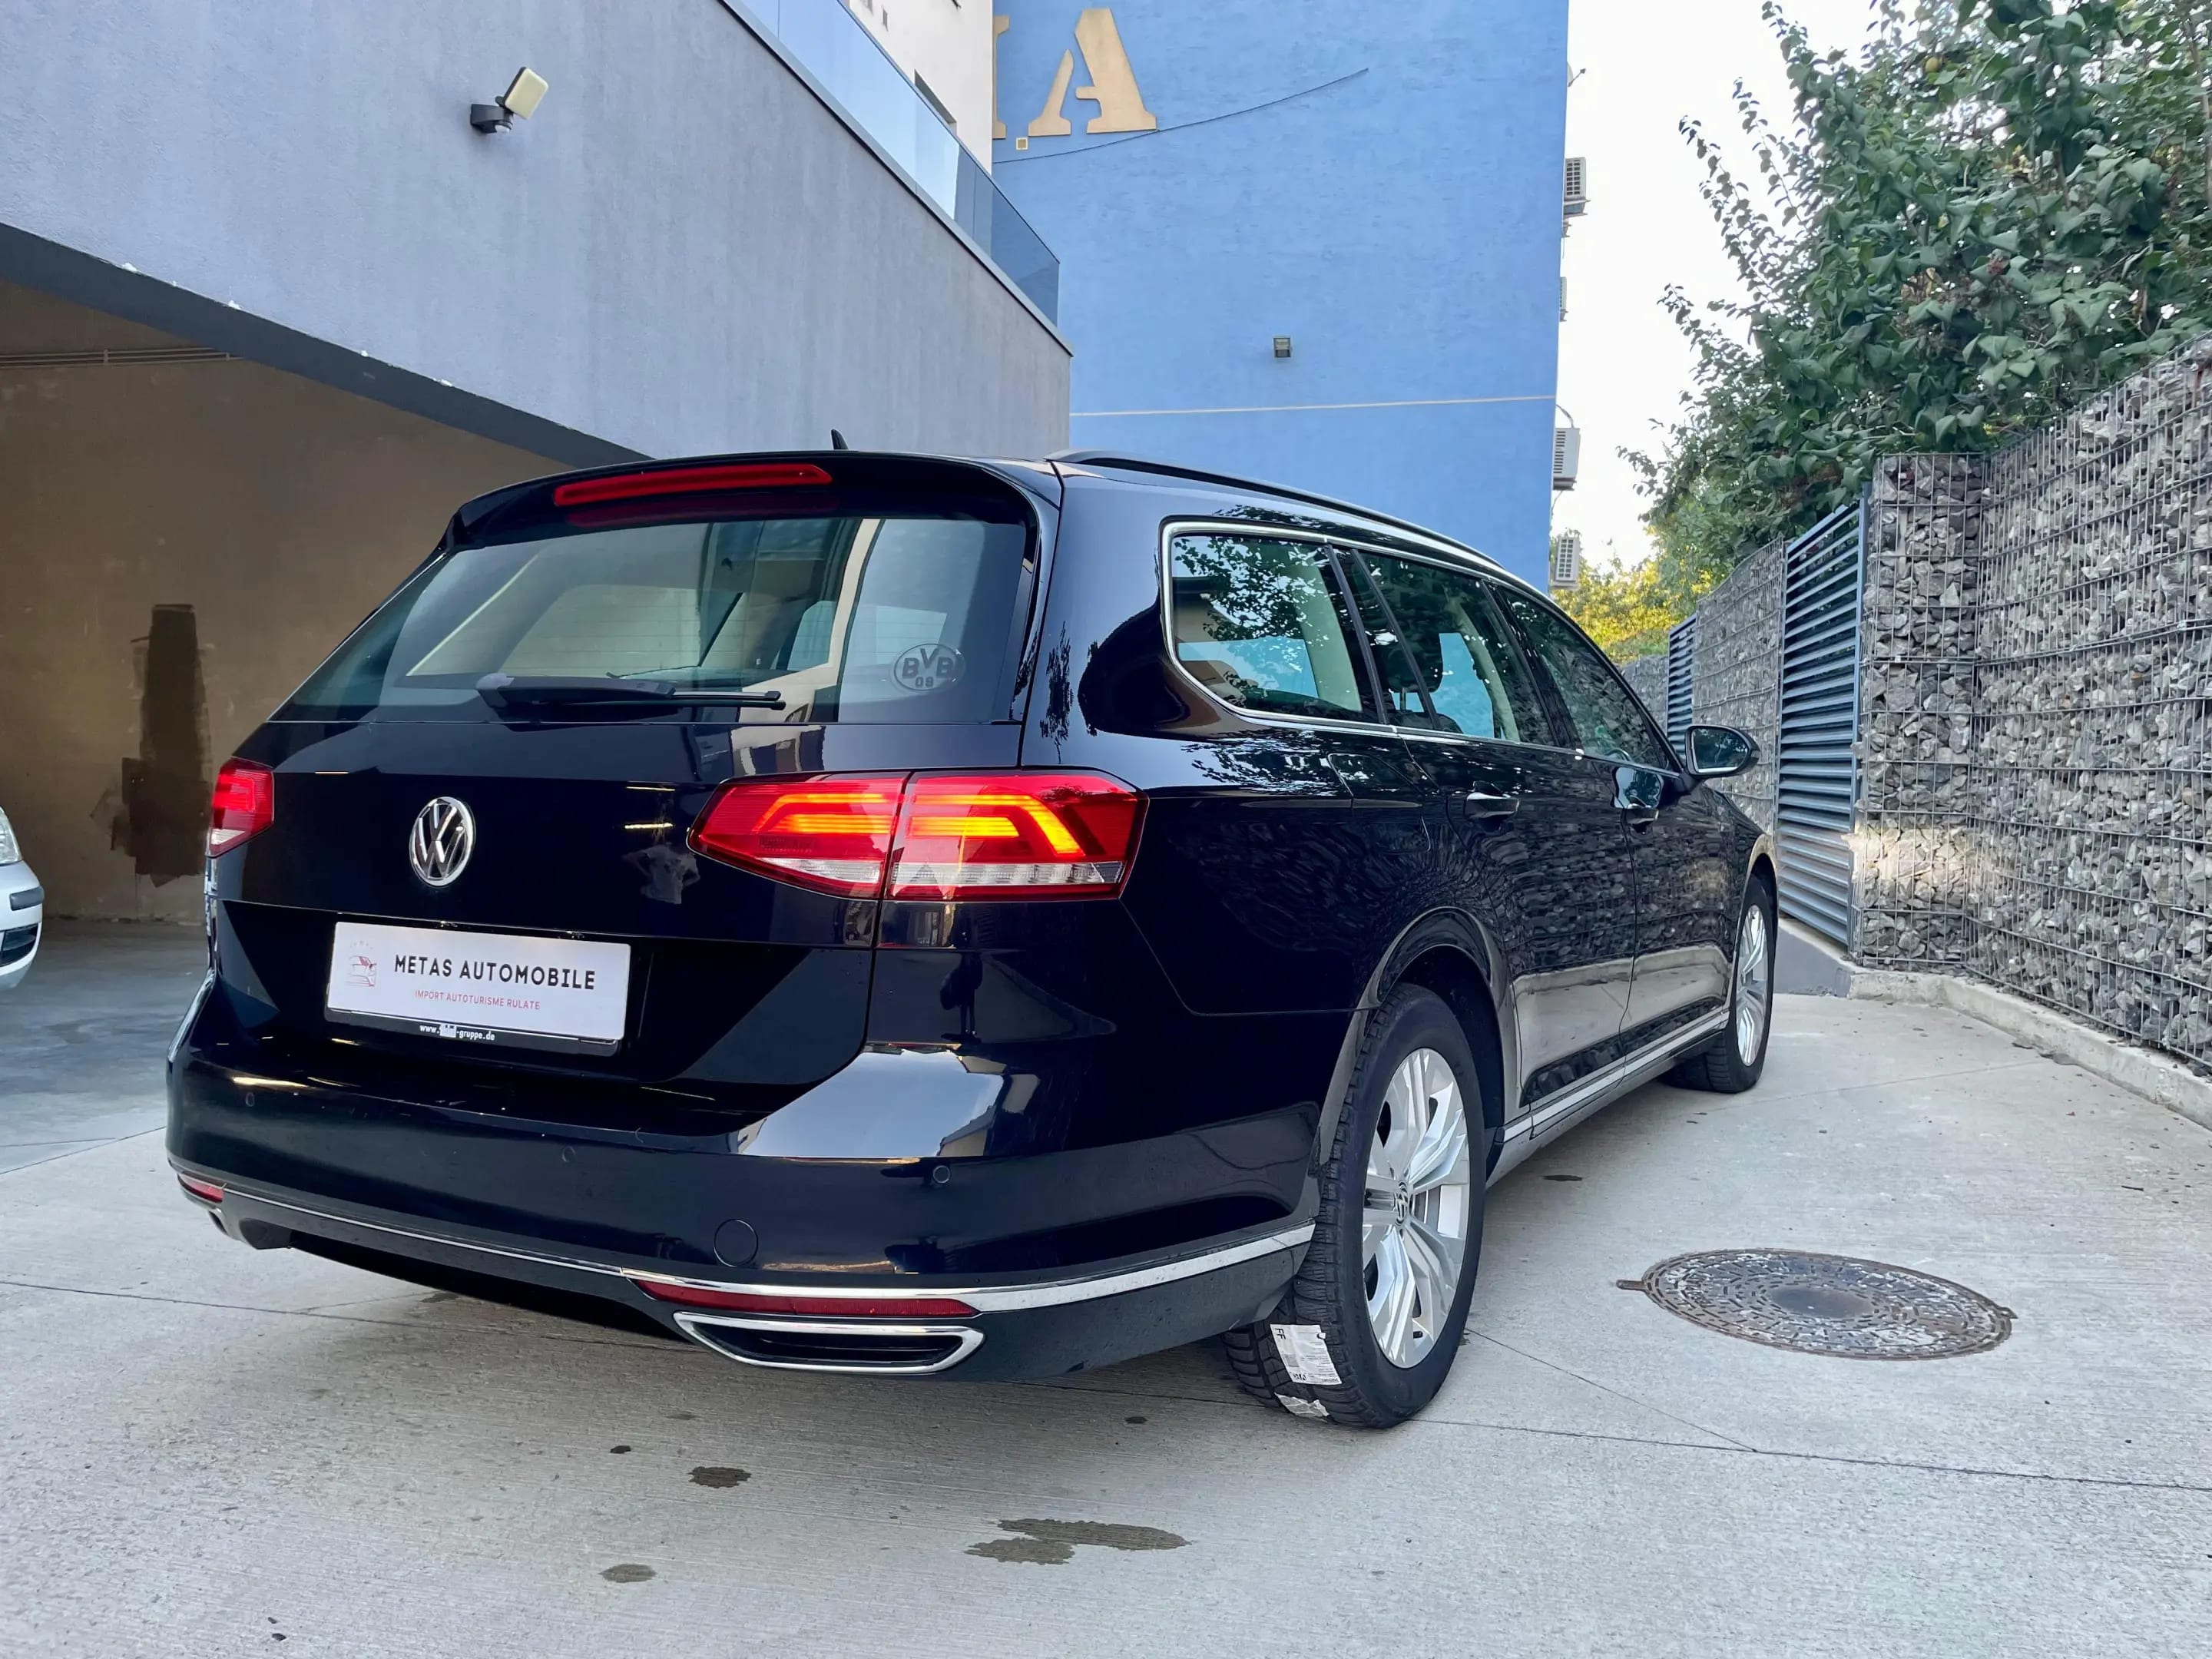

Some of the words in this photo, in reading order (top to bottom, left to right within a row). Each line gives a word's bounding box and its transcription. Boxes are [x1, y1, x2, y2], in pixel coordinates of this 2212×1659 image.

[902, 647, 955, 679] BVB
[915, 676, 934, 687] 09
[409, 796, 475, 887] VW
[394, 954, 452, 977] METAS
[459, 960, 595, 990] AUTOMOBILE
[416, 990, 444, 1001] IMPORT
[446, 993, 505, 1007] AUTOTURISME
[507, 998, 540, 1010] RULATE
